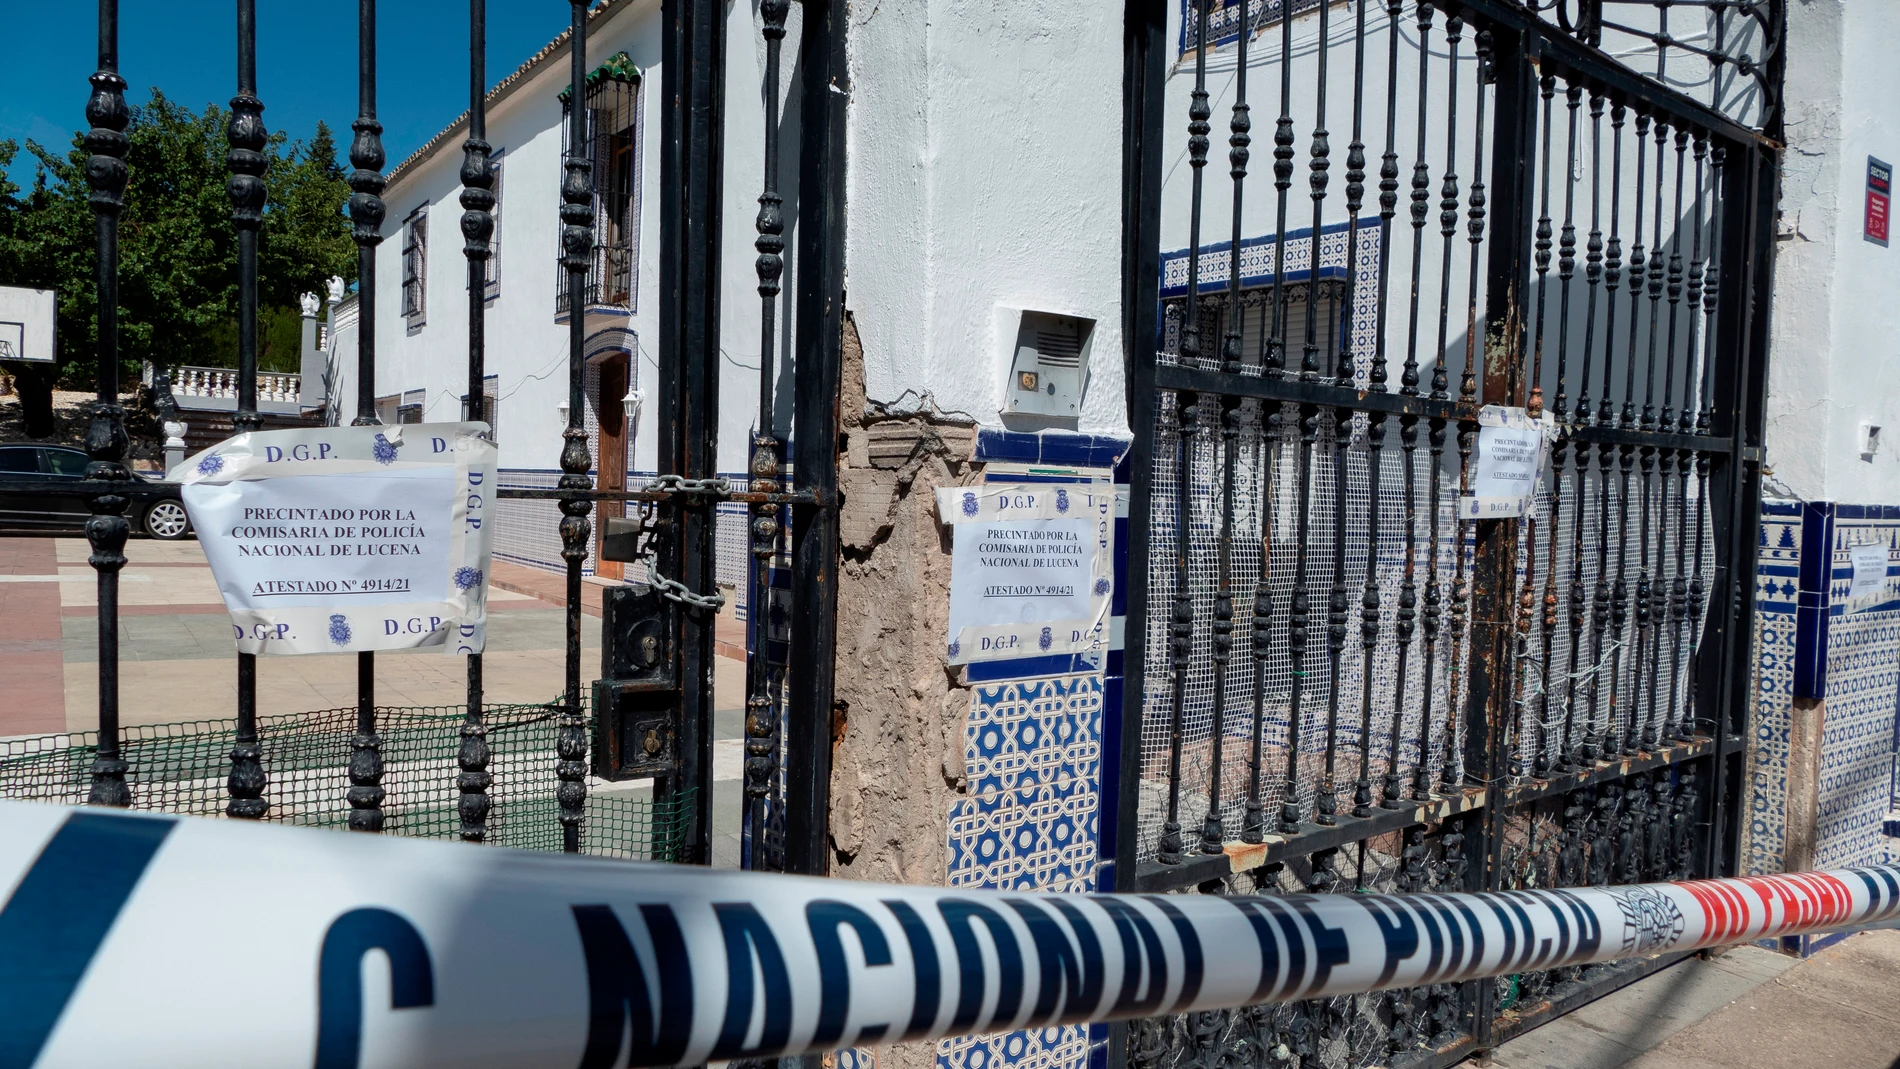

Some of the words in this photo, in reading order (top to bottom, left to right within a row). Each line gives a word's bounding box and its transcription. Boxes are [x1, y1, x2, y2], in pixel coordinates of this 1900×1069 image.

[1870, 166, 1889, 181] SECTOR
[265, 442, 338, 463] D.G.P.
[465, 471, 484, 534] D.G.P.
[999, 495, 1039, 510] D.G.P.
[1490, 503, 1511, 511] D.G.P.
[244, 508, 354, 521] PRECINTADO
[359, 509, 391, 521] POR
[396, 510, 416, 521] LA
[231, 526, 329, 539] COMISARIA
[334, 527, 356, 539] DE
[361, 523, 426, 538] POLICÍA
[987, 529, 1045, 541] PRECINTADO
[1046, 531, 1063, 541] POR
[1065, 531, 1078, 541] LA
[239, 544, 325, 557] NACIONAL
[330, 544, 352, 556] DE
[357, 543, 421, 556] LUCENA
[978, 543, 1034, 554] COMISARIA
[1036, 544, 1047, 554] DE
[1048, 543, 1083, 554] POLICÍA
[980, 557, 1031, 568] NACIONAL
[1033, 558, 1045, 568] DE
[1047, 558, 1079, 568] LUCENA
[252, 580, 337, 594] ATESTADO
[361, 578, 410, 591] 4914/21
[983, 585, 1033, 596] ATESTADO
[1046, 585, 1074, 595] 4914/21
[383, 616, 445, 635] D.G.P.
[981, 635, 1020, 651] D.G.P.
